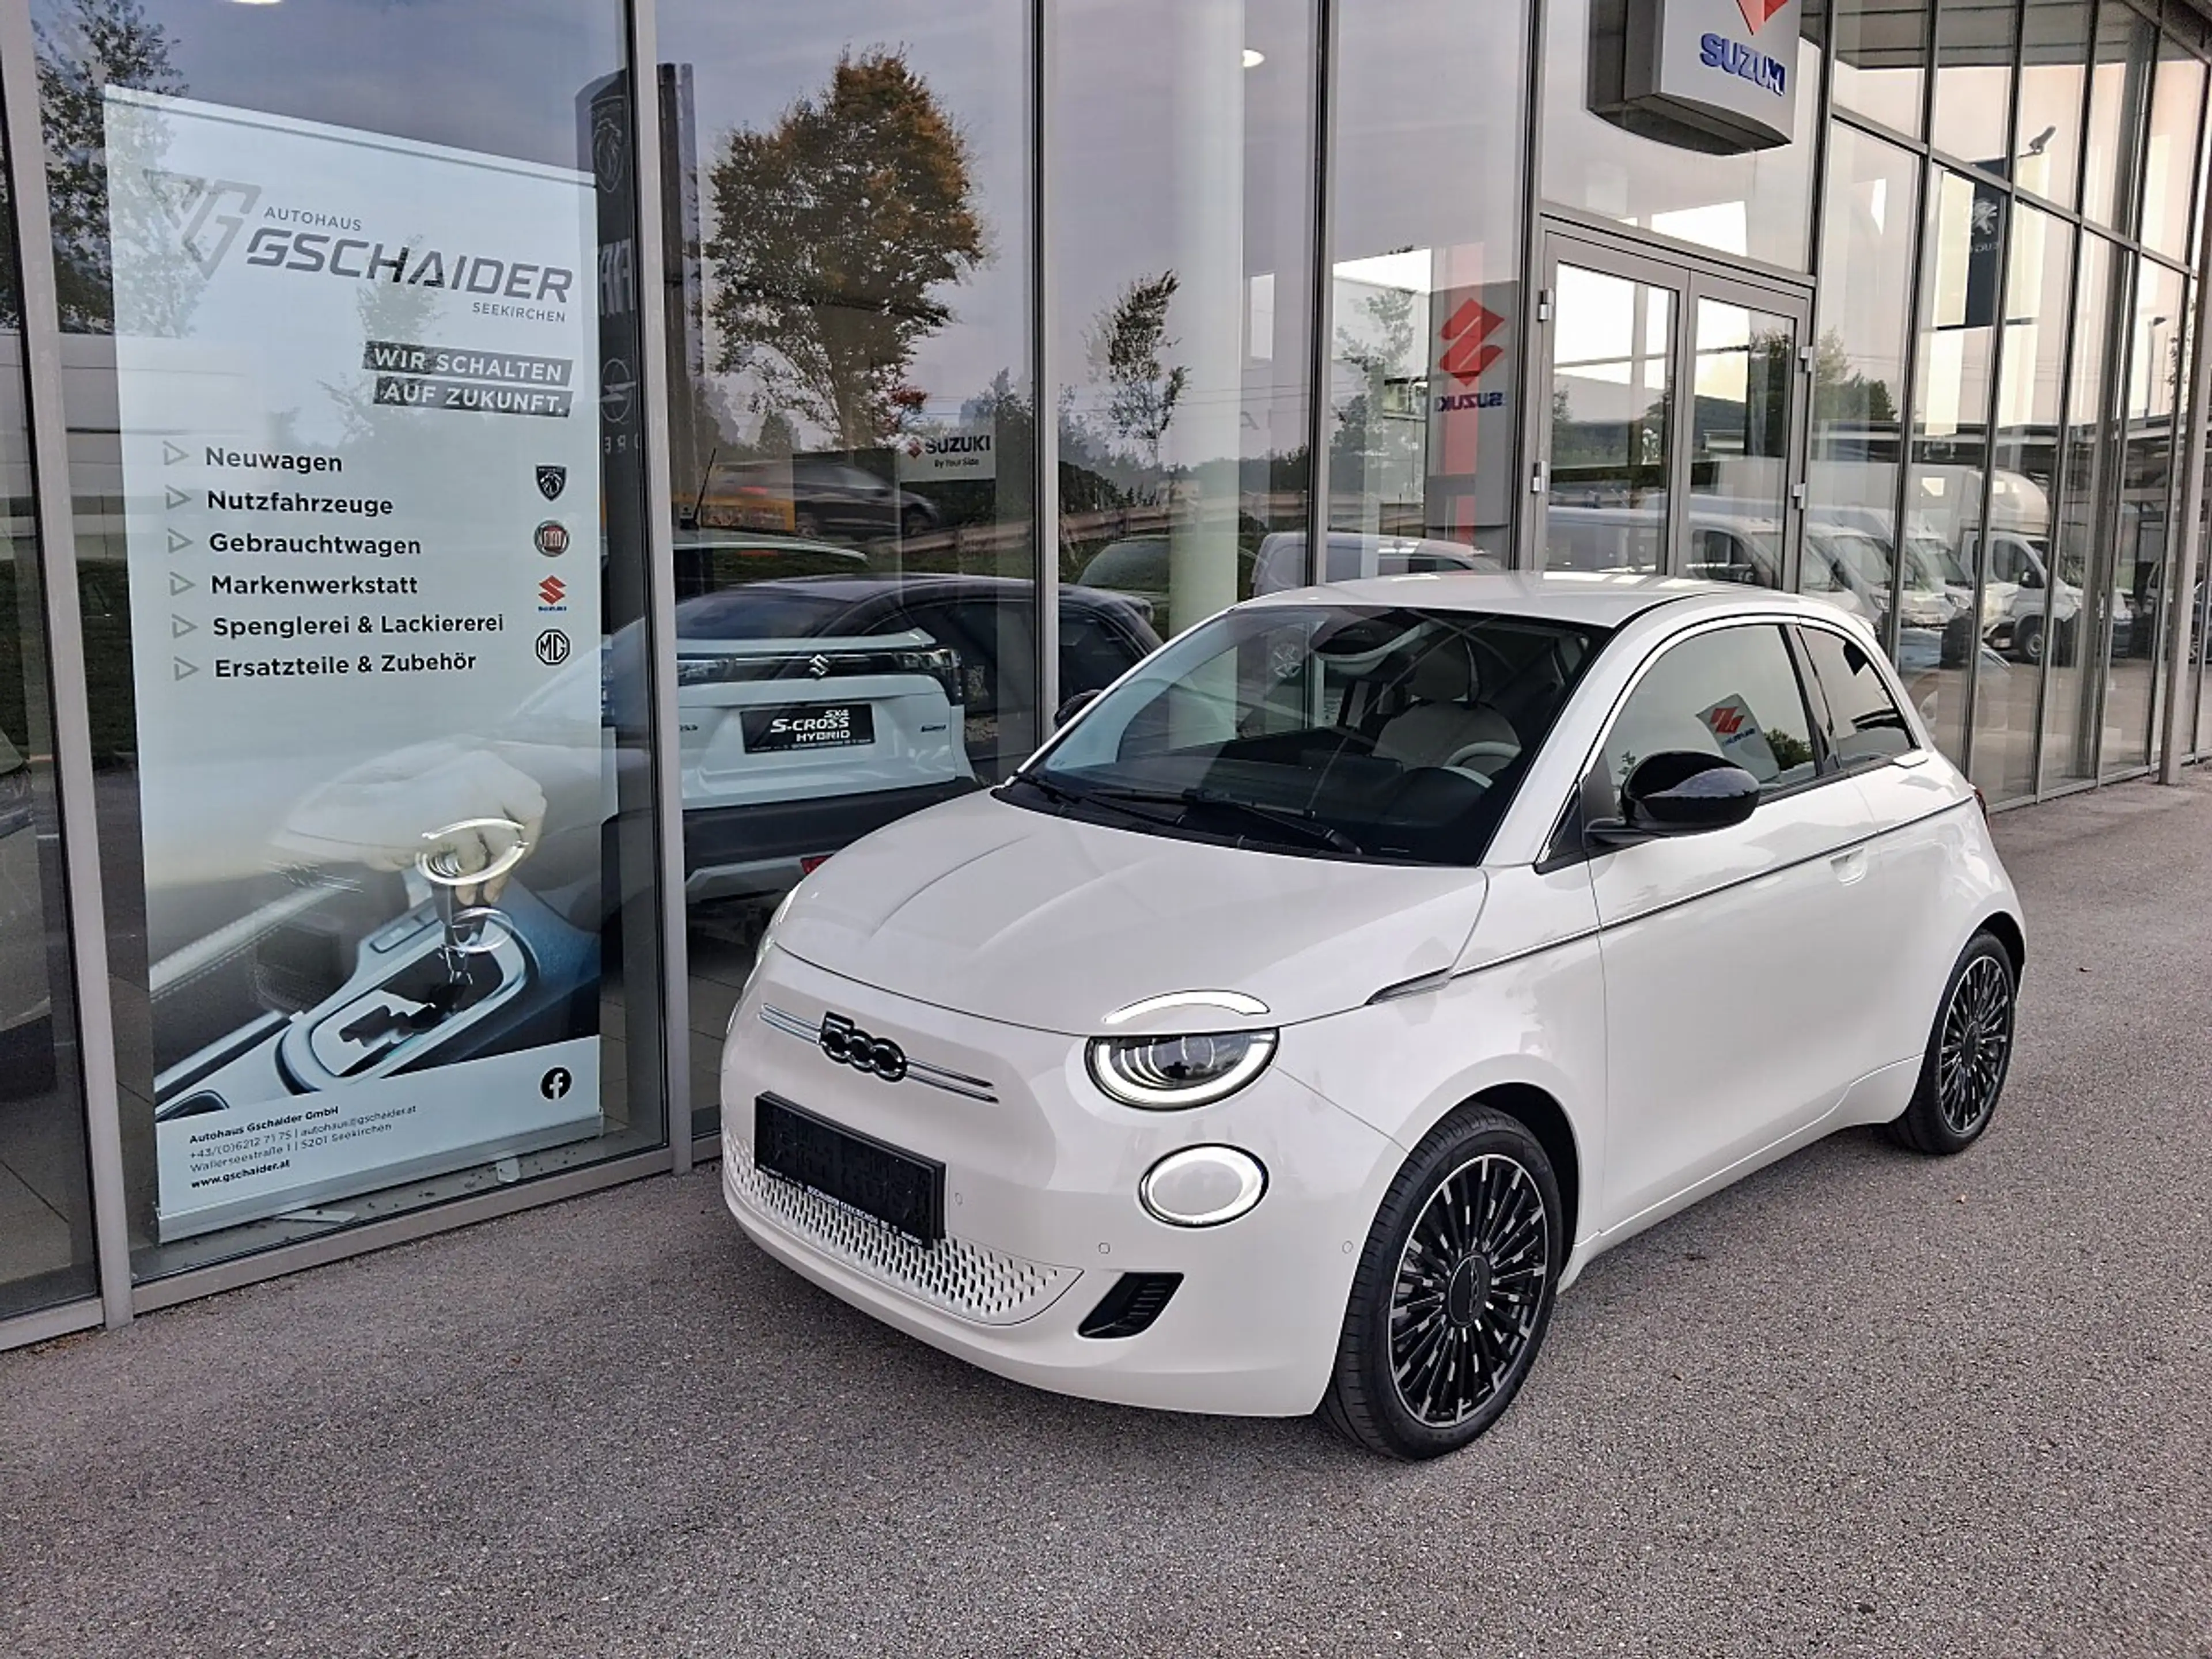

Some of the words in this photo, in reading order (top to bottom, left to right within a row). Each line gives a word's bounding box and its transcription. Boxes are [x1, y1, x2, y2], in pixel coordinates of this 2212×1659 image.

[1699, 33, 1786, 96] SUZUKI
[264, 206, 362, 230] AUTOHAUS
[247, 228, 573, 303] GSCHAIDER
[472, 302, 566, 323] SEEKIRCHEN
[374, 347, 425, 370] WIR
[437, 354, 563, 382] SCHALTEN
[384, 382, 435, 404] AUF
[446, 387, 565, 414] ZUKUNFT.
[926, 435, 991, 454] SUZUKI
[206, 446, 343, 474] Neuwagen
[934, 459, 943, 468] By
[207, 490, 393, 517] Nutzfahrzeuge
[209, 533, 421, 557] Gebrauchtwagen
[211, 575, 418, 594] Markenwerkstatt
[213, 617, 349, 639] Spenglerei
[358, 617, 373, 634] &
[381, 613, 503, 633] Lackiererei
[215, 656, 349, 677] Ersatzteile
[358, 656, 373, 673] &
[381, 652, 476, 672] Zubehör
[770, 718, 849, 733] S-CROSS
[796, 730, 850, 742] HYBRID
[820, 1011, 907, 1082] 500
[190, 1126, 244, 1144] Autohaus
[247, 1114, 302, 1132] Gschaider
[306, 1105, 339, 1120] GmbH
[278, 1130, 292, 1140] 75
[301, 1136, 328, 1149] 5201
[331, 1123, 392, 1142] Seekirchen
[191, 1159, 290, 1188] www.gschaider.at
